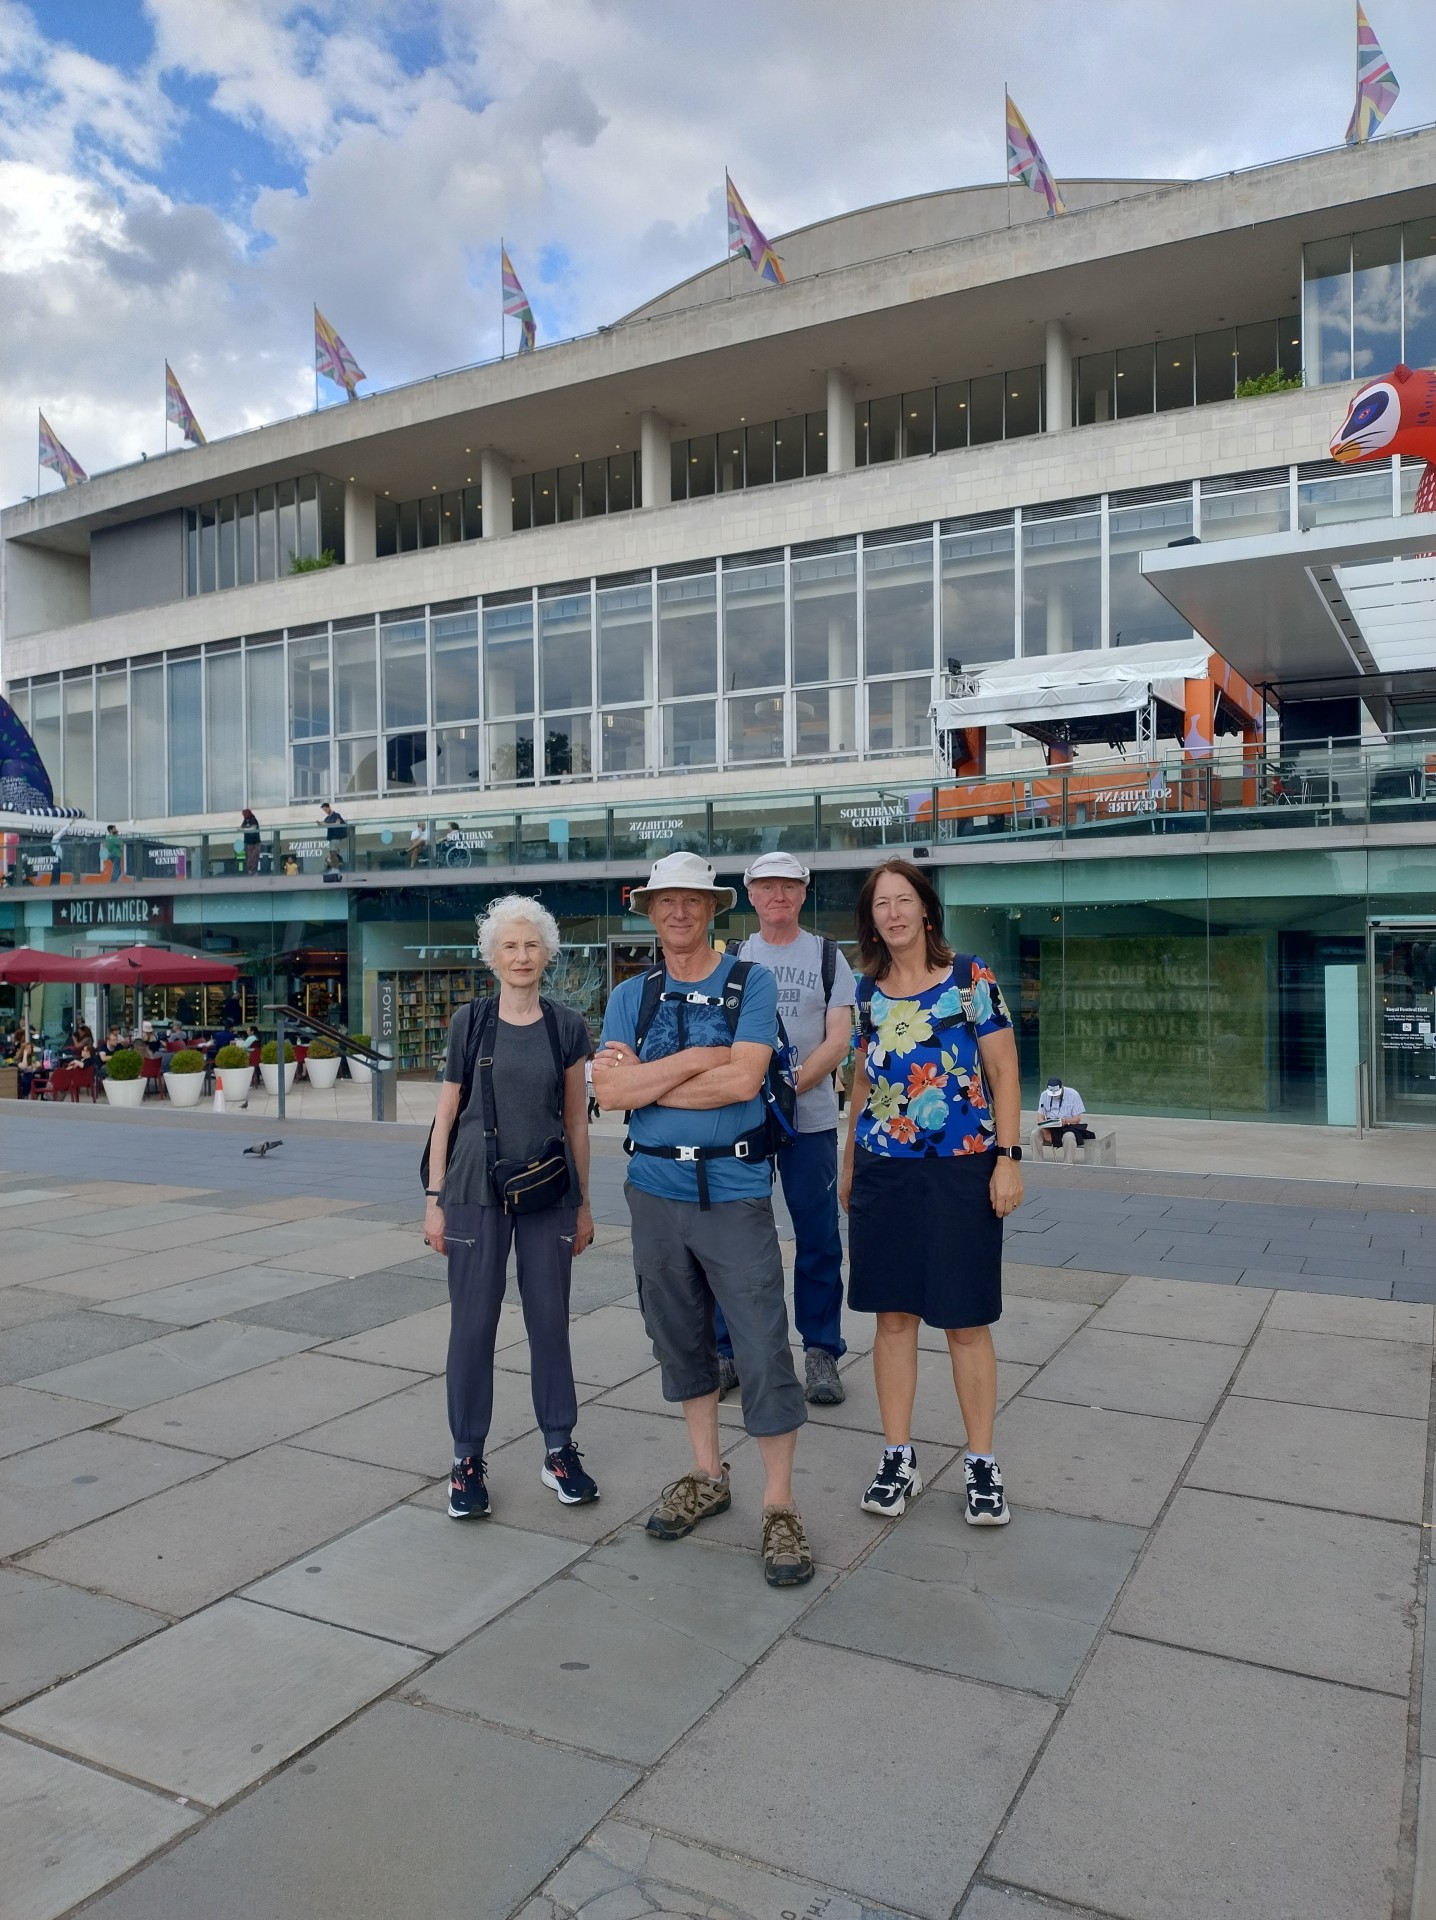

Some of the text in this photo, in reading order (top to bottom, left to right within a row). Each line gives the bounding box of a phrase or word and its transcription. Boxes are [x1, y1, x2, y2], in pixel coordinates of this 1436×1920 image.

[840, 805, 904, 819] SOUTHBANK
[851, 816, 893, 828] CENTRE
[446, 830, 494, 841] SOUTHBANK
[455, 840, 486, 849] CENTRE
[148, 848, 186, 858] SOUTHBANK
[155, 856, 179, 865] CENTRE
[70, 900, 149, 924] PRET A MANGER
[773, 965, 818, 990] NNAH
[778, 990, 799, 1001] 733
[382, 986, 392, 1036] FOYLES
